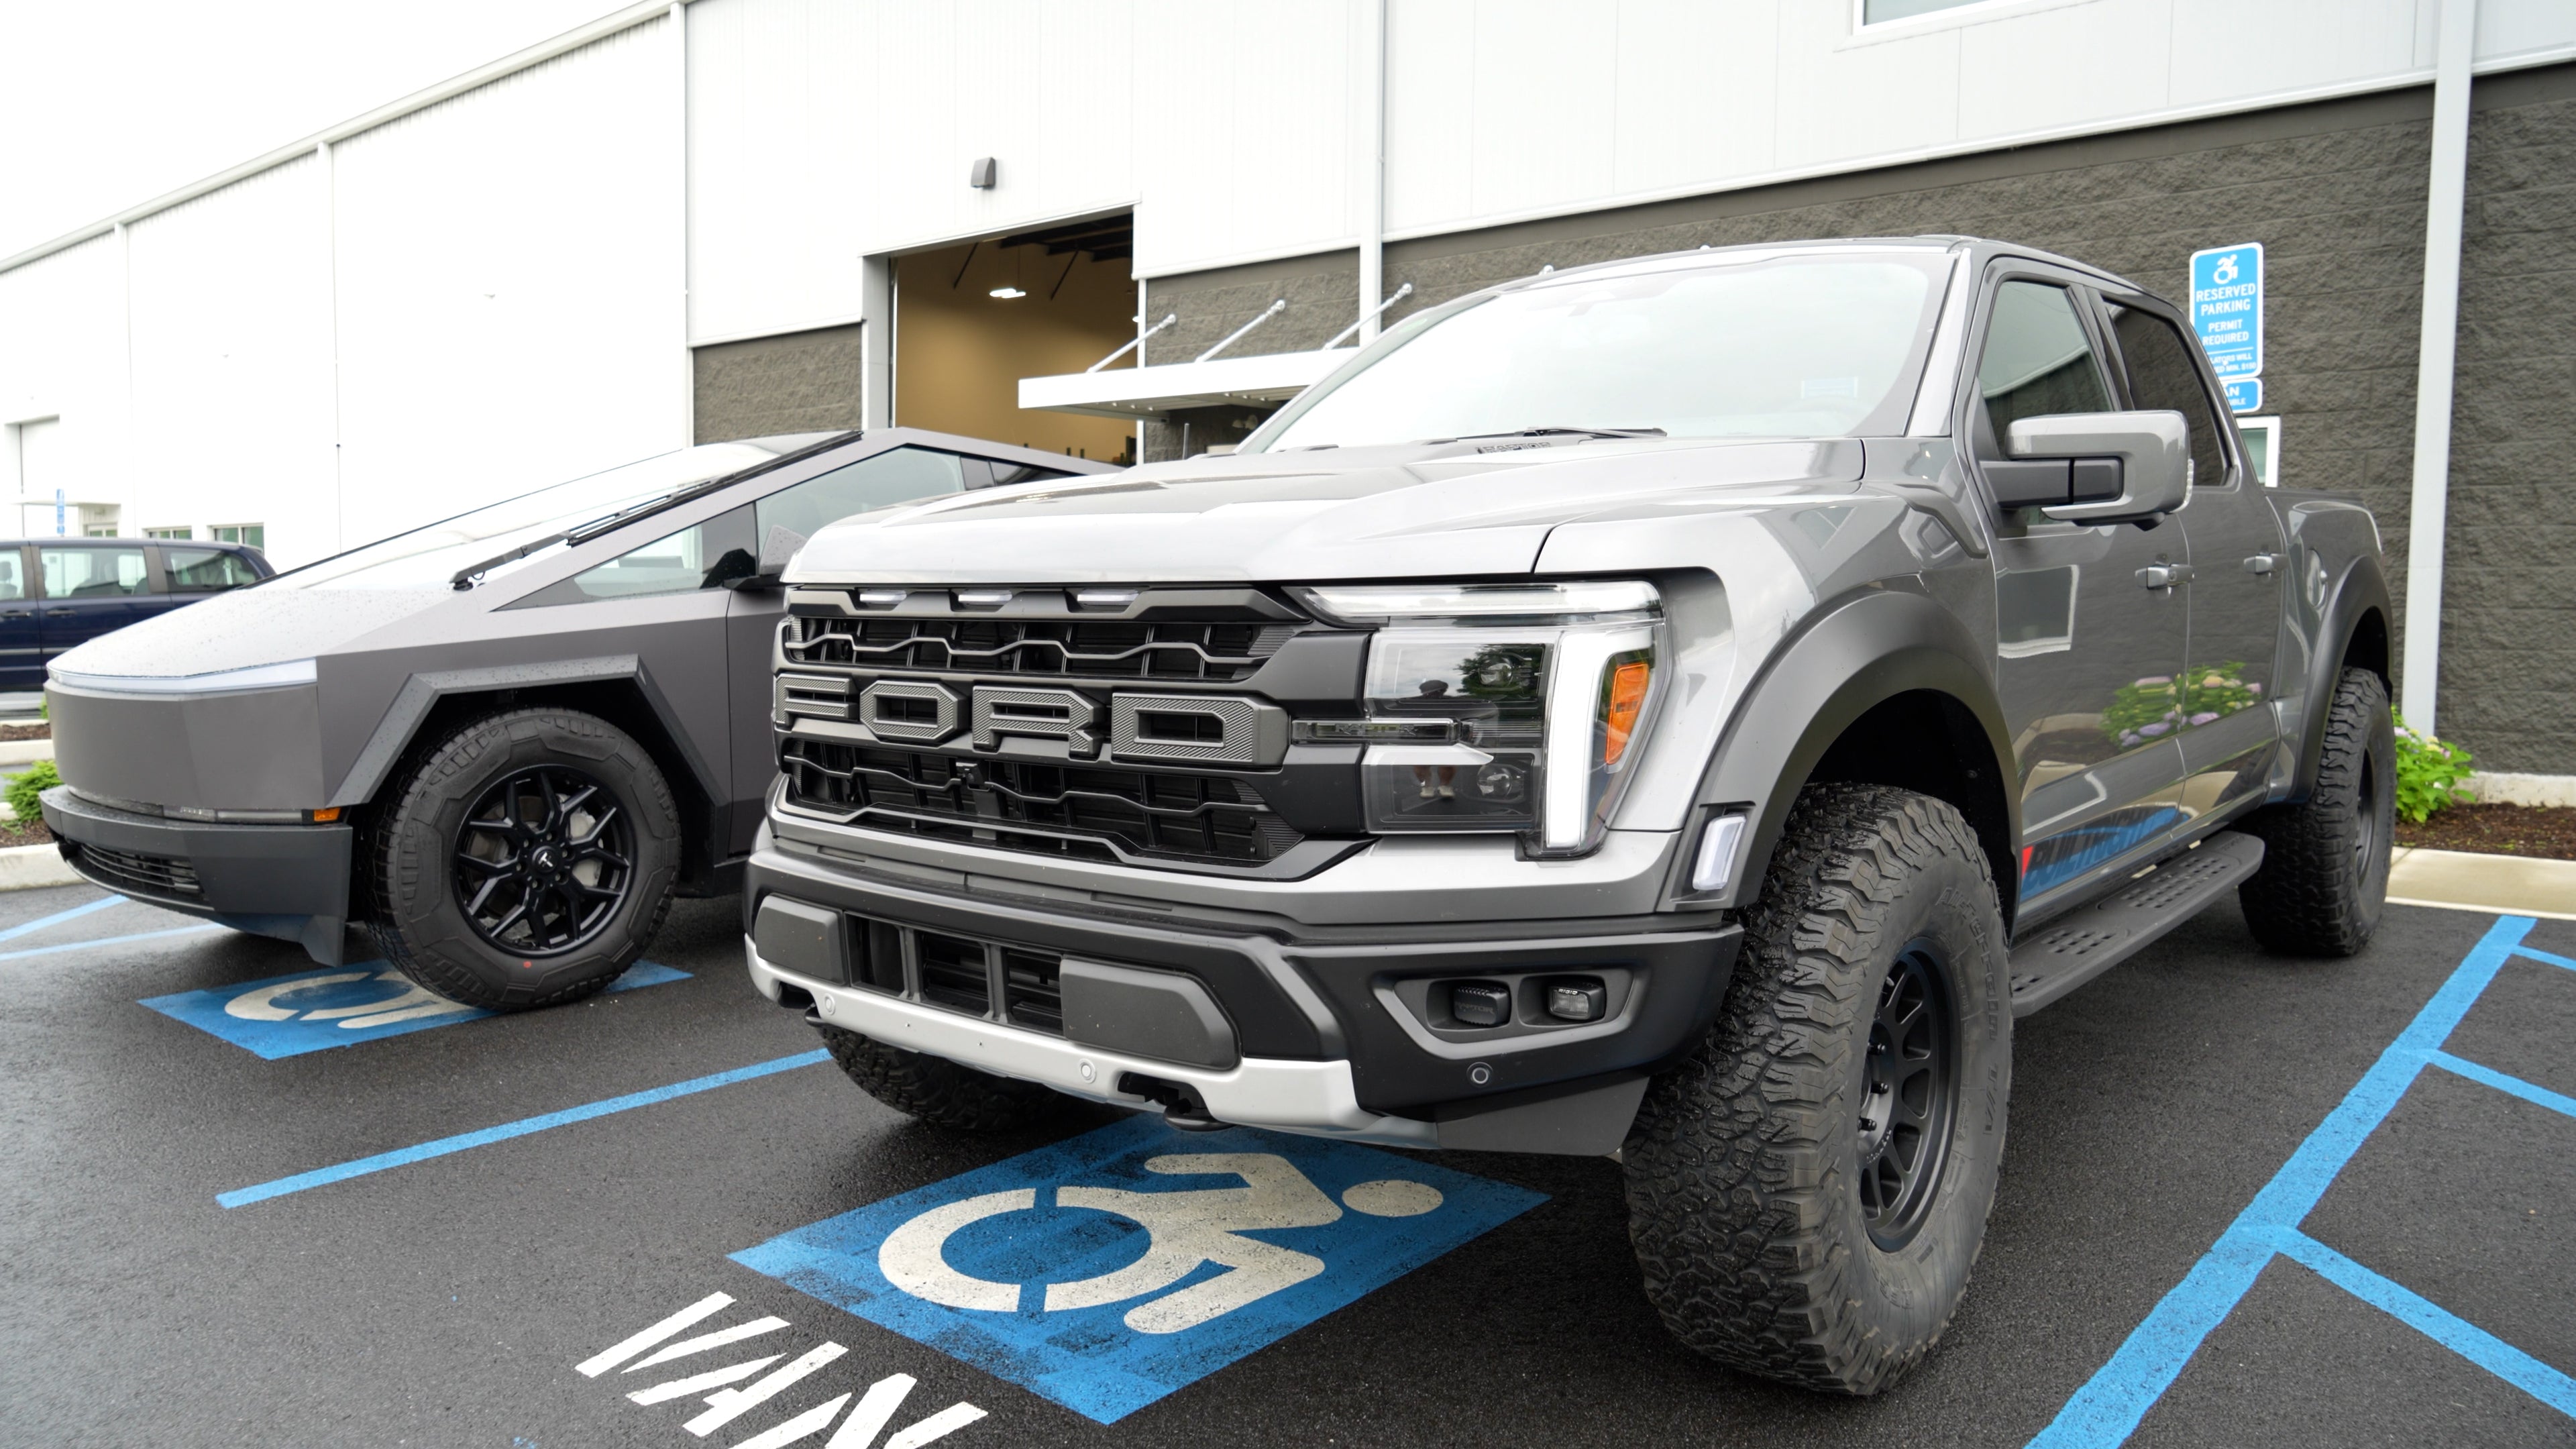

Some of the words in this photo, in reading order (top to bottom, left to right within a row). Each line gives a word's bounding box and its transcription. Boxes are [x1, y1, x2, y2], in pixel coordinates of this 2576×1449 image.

[2196, 283, 2256, 302] RESERVED
[2201, 299, 2251, 316] PARKING
[2208, 319, 2243, 333] PERMIT
[2202, 331, 2249, 346] REQUIRED
[2210, 355, 2235, 364] LATORS
[2236, 353, 2253, 361] WILL
[1477, 442, 1551, 454] RAPTOR
[773, 673, 1291, 767] FORD
[1334, 723, 1417, 736] RAPTOR
[574, 1291, 989, 1449] VAN
